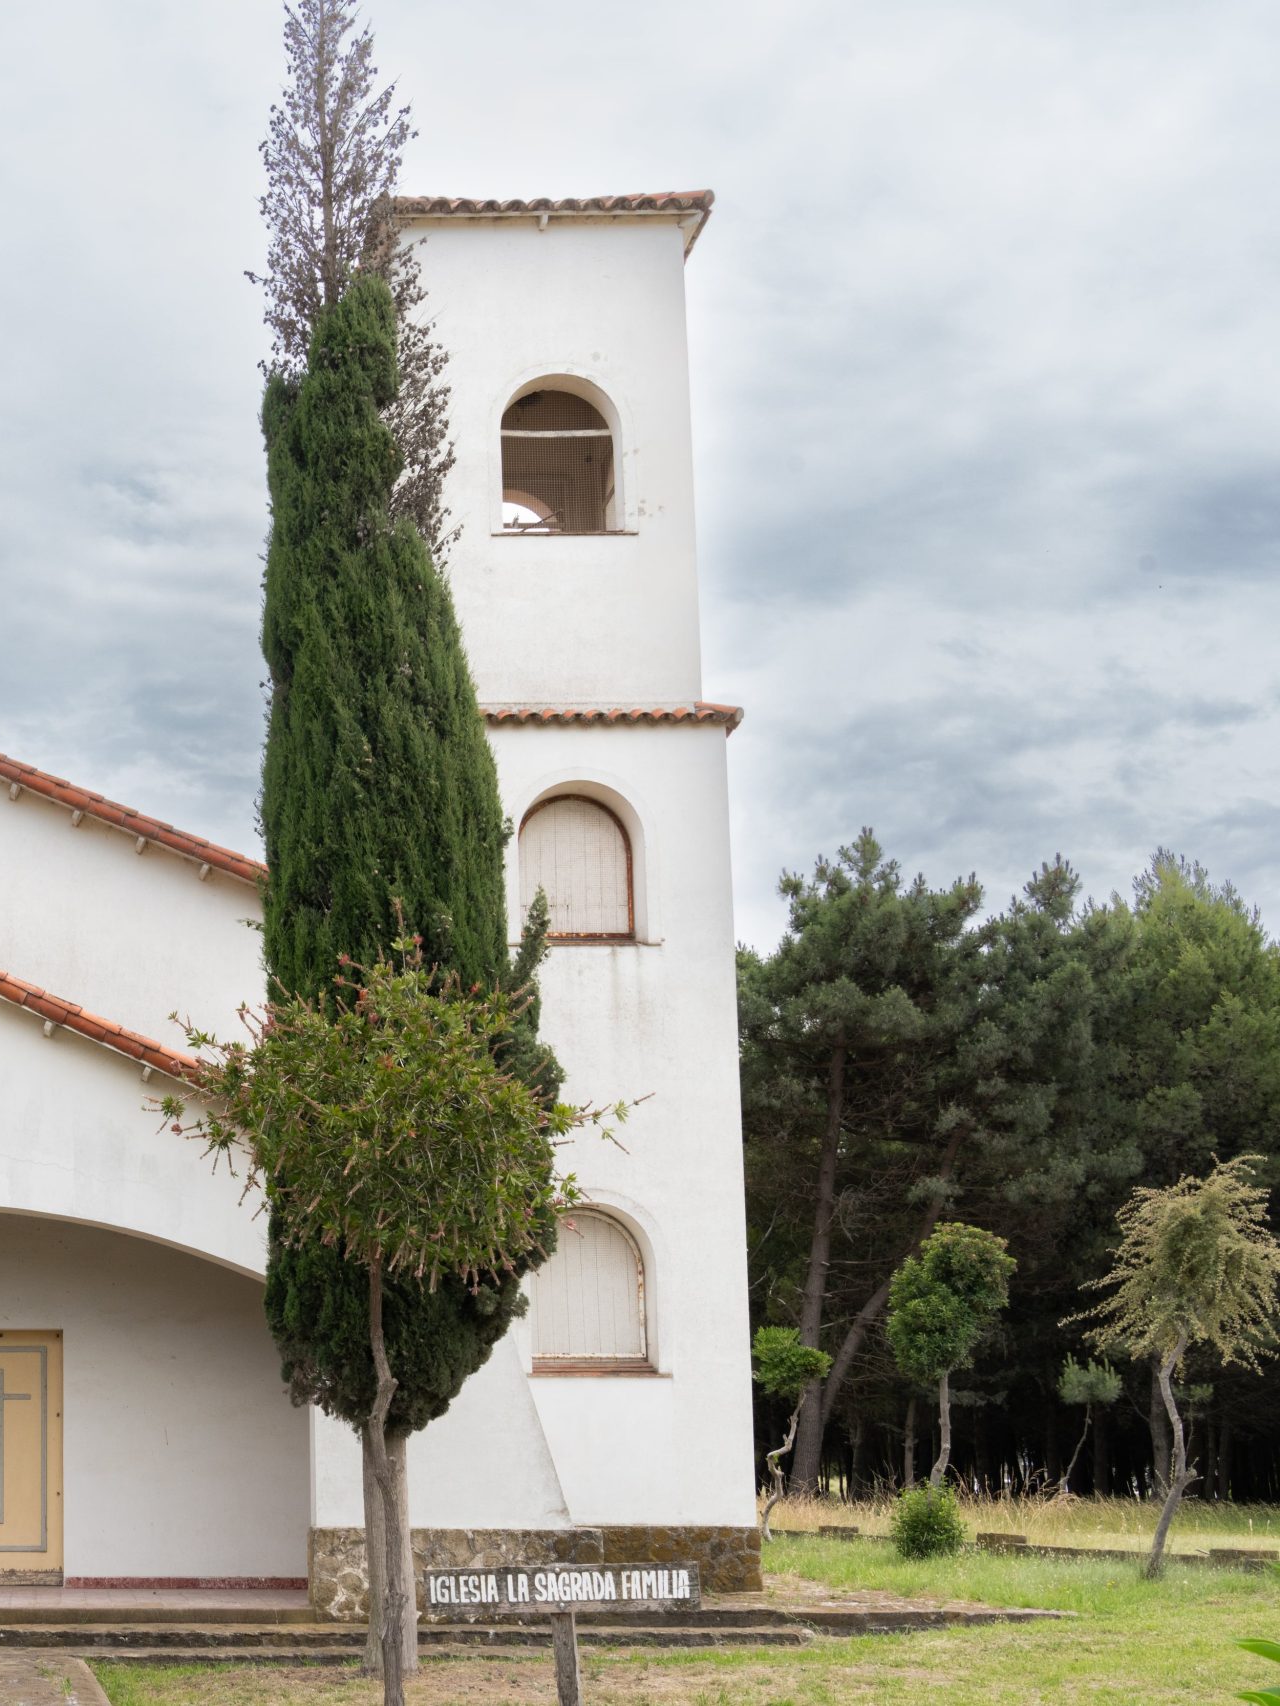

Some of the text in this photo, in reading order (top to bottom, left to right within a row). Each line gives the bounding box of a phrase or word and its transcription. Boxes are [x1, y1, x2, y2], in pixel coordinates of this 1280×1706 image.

[430, 1569, 690, 1603] IGLESIA LA SAGRADA FAMILIA
